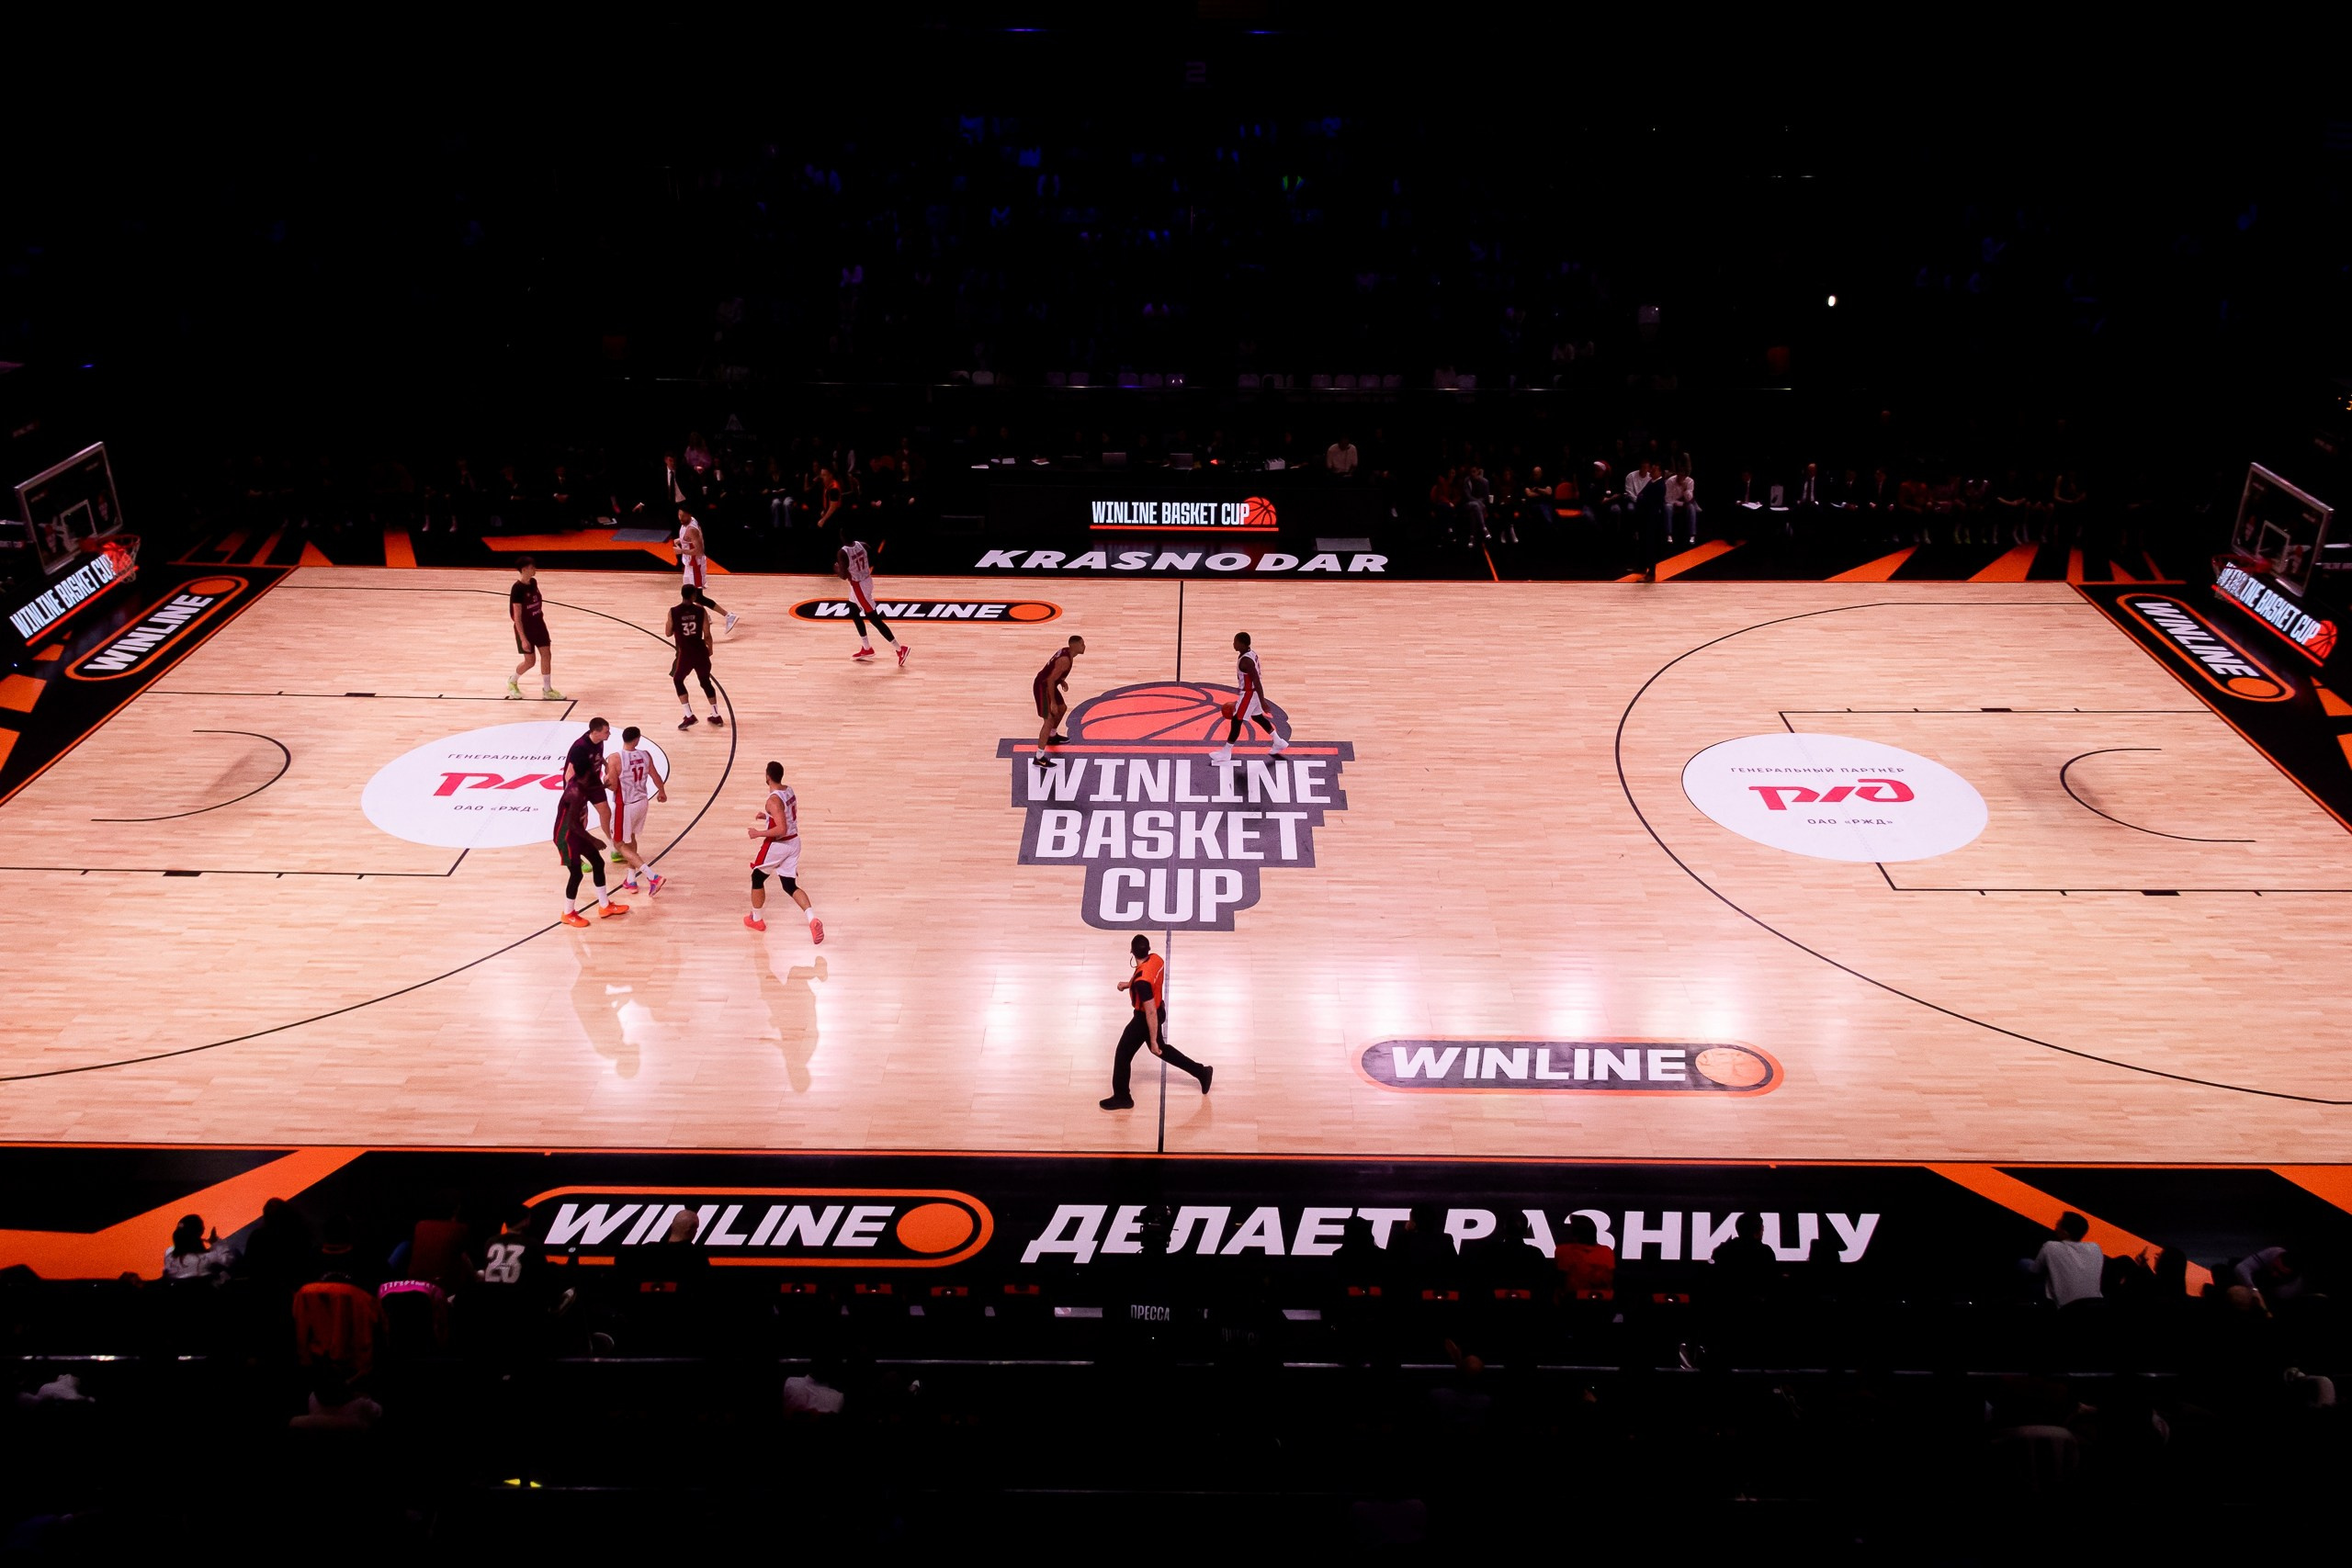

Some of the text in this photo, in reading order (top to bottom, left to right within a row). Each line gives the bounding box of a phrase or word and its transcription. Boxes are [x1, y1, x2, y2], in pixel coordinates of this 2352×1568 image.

[1091, 501, 1250, 525] WINLINE BASKET CUP
[974, 549, 1389, 572] KRASNODAR
[9, 588, 67, 639] WINLINE
[53, 564, 101, 609] BASKET
[814, 602, 1008, 618] WNLINE
[2254, 588, 2302, 633] BASKET
[2290, 614, 2322, 646] CUP
[83, 593, 215, 671] WINLINE
[681, 621, 696, 636] 32
[2133, 602, 2261, 677] WINLINE
[1026, 757, 1331, 804] WINLINE
[1035, 809, 1308, 861] BASKET
[1099, 867, 1243, 923] CUP
[1391, 1046, 1686, 1081] WINLINE
[485, 1243, 526, 1283] 23
[1130, 1303, 1170, 1322] ПРЕССА
